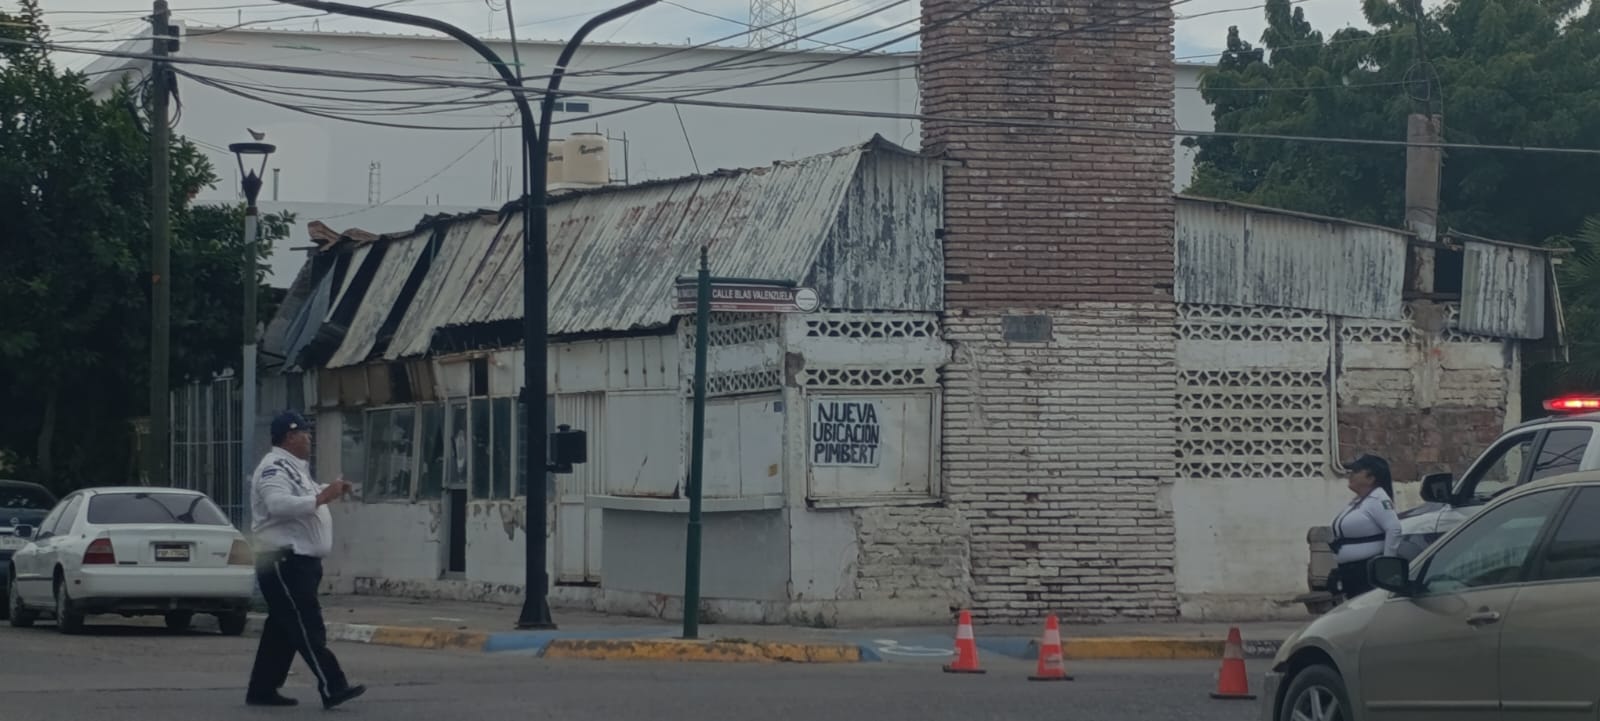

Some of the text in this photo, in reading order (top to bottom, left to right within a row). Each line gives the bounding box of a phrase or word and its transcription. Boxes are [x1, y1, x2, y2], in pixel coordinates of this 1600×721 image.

[712, 288, 794, 302] CALLE BLAS VALENZUELA
[818, 402, 877, 423] NUEVA
[814, 443, 877, 464] PIMBERT
